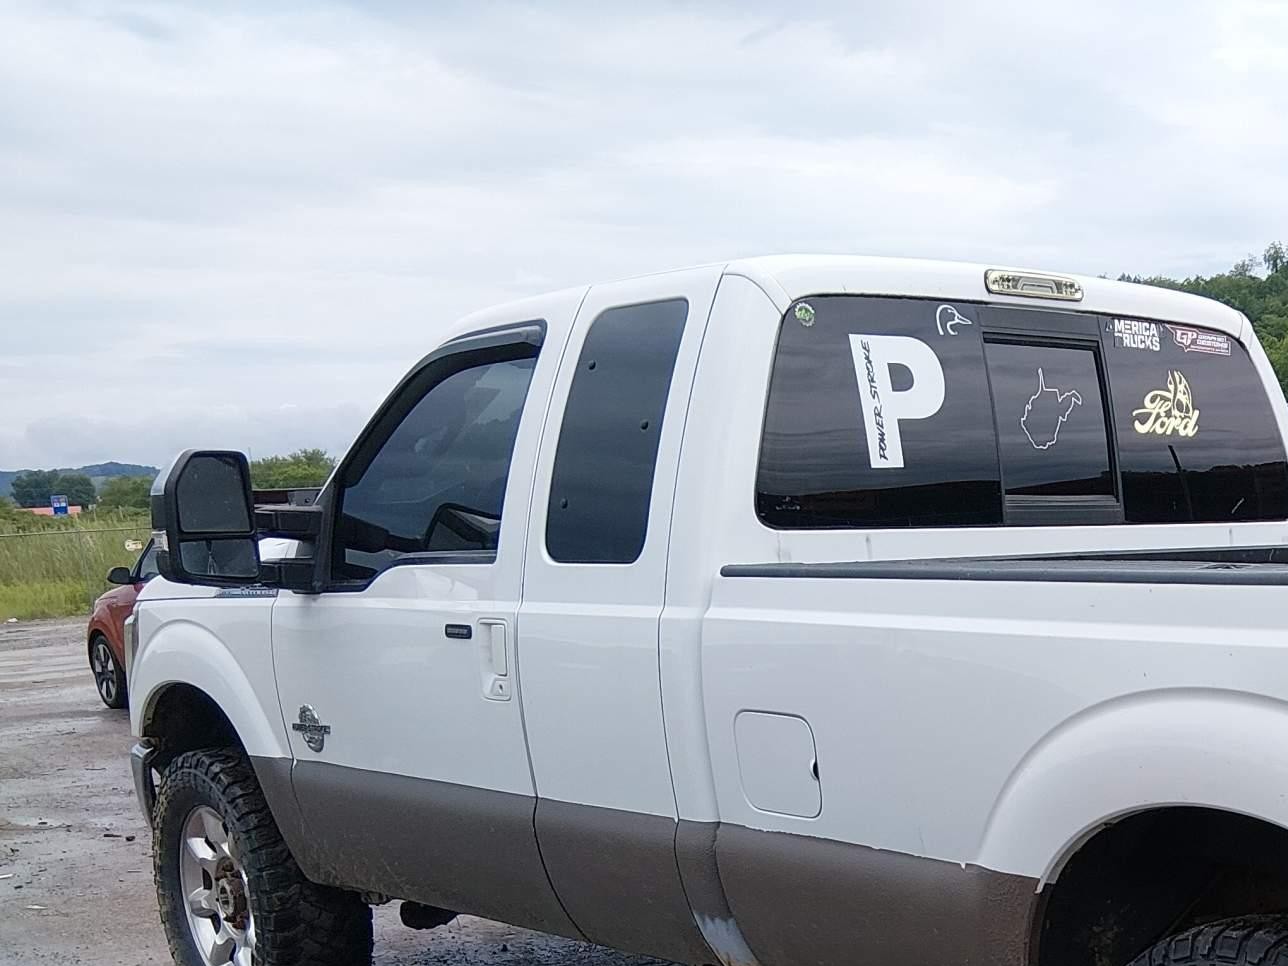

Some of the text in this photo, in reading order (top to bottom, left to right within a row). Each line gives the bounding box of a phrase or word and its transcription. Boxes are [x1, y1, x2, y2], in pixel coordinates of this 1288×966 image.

[848, 333, 946, 469] P
[860, 339, 889, 461] POWER STROKE
